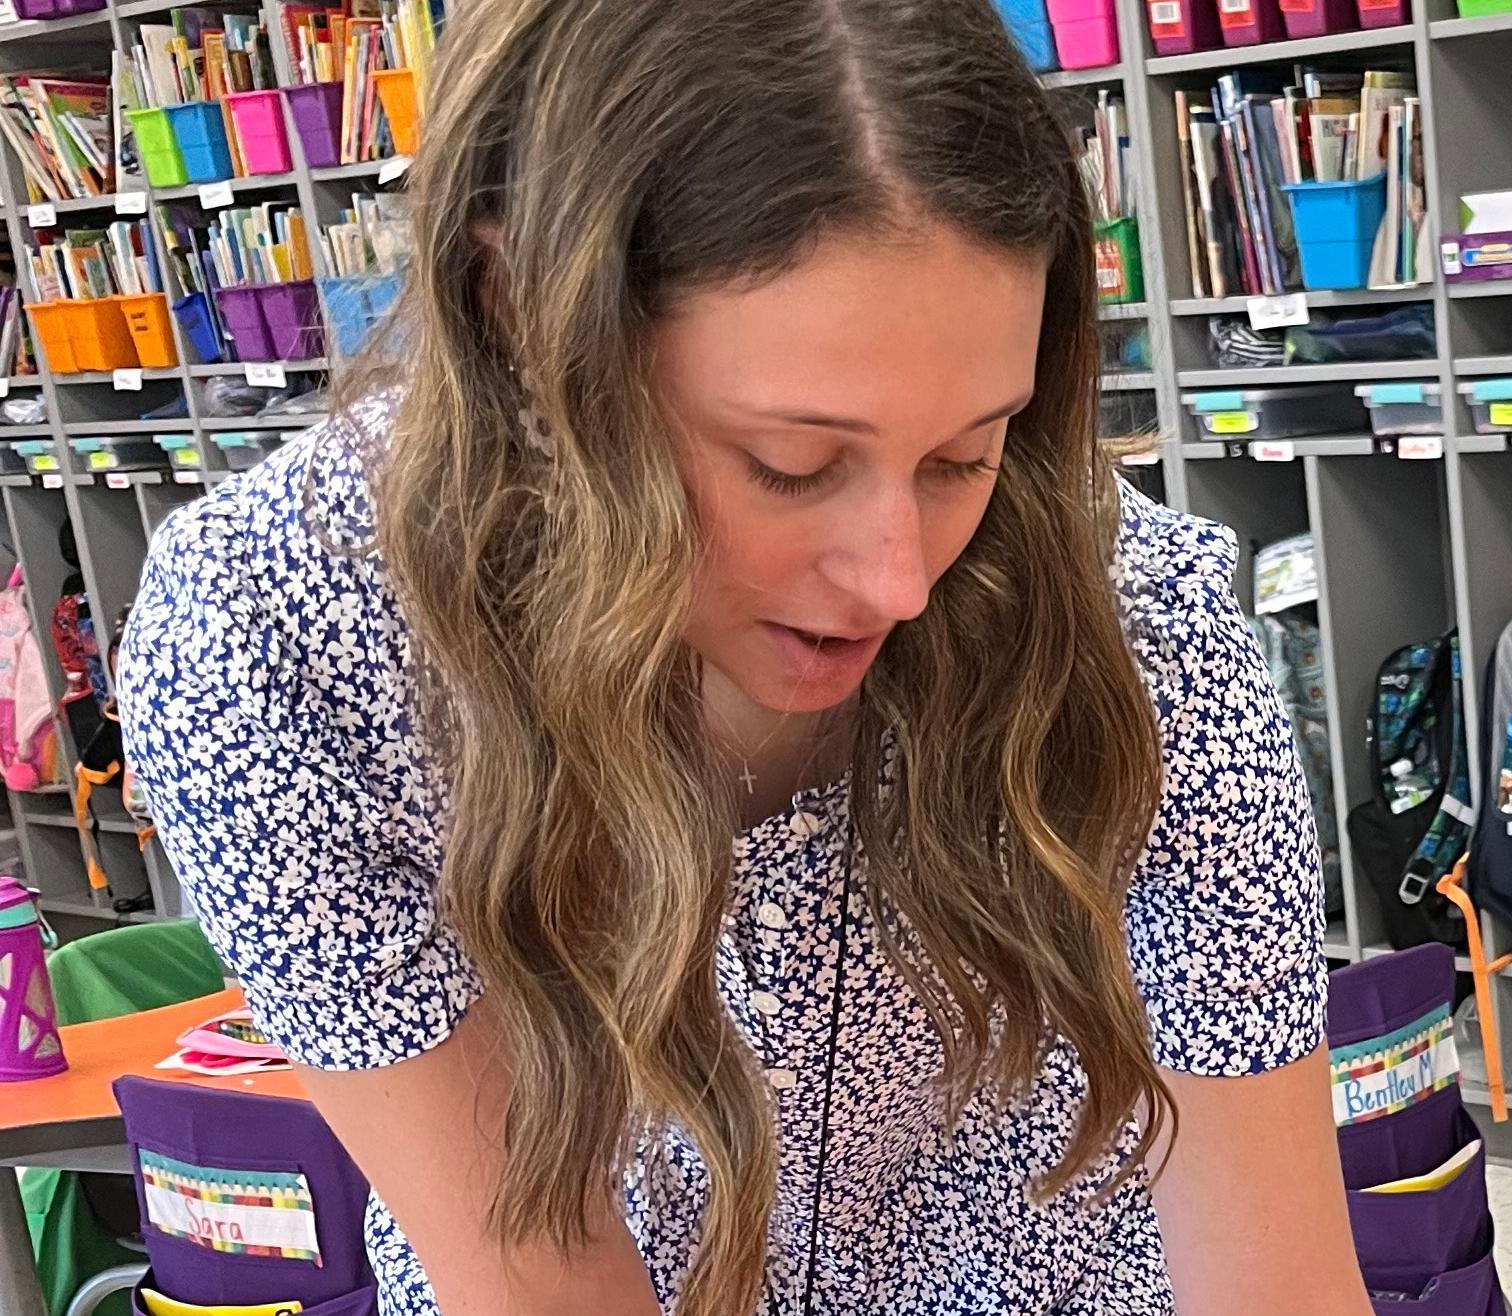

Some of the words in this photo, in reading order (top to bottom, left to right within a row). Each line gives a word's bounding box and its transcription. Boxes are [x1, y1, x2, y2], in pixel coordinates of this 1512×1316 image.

[1344, 1071, 1416, 1117] Bentley
[1419, 1051, 1434, 1087] M
[185, 1198, 244, 1242] Sara
